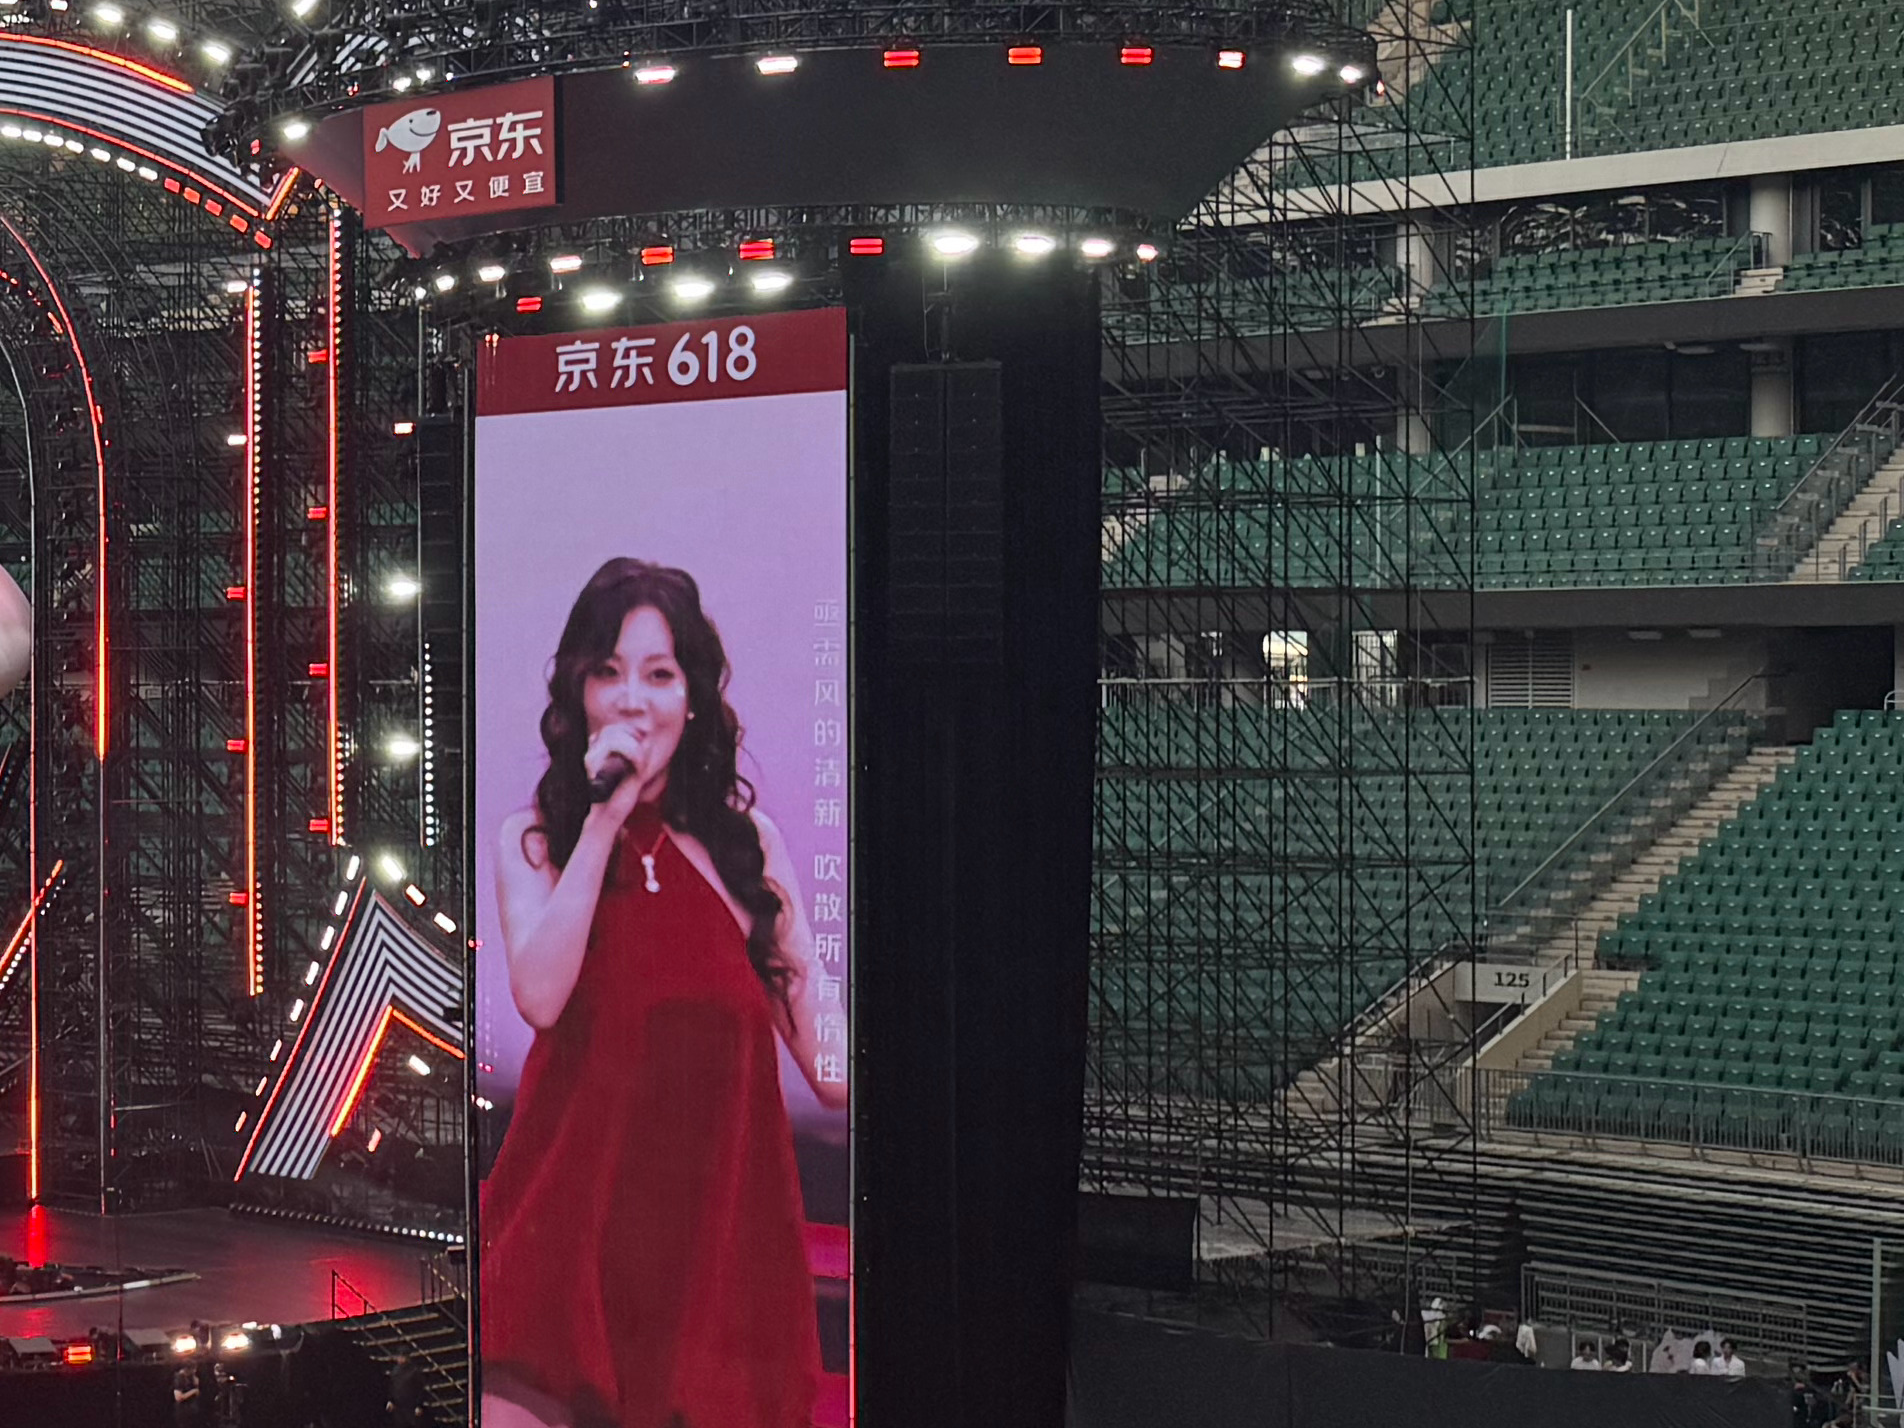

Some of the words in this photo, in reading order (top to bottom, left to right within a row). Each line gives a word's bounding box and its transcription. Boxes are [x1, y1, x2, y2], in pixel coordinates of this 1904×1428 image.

[447, 111, 543, 167] 京东
[386, 171, 544, 212] 又好又便宜
[555, 324, 758, 392] 京东618
[1494, 971, 1530, 988] 125
